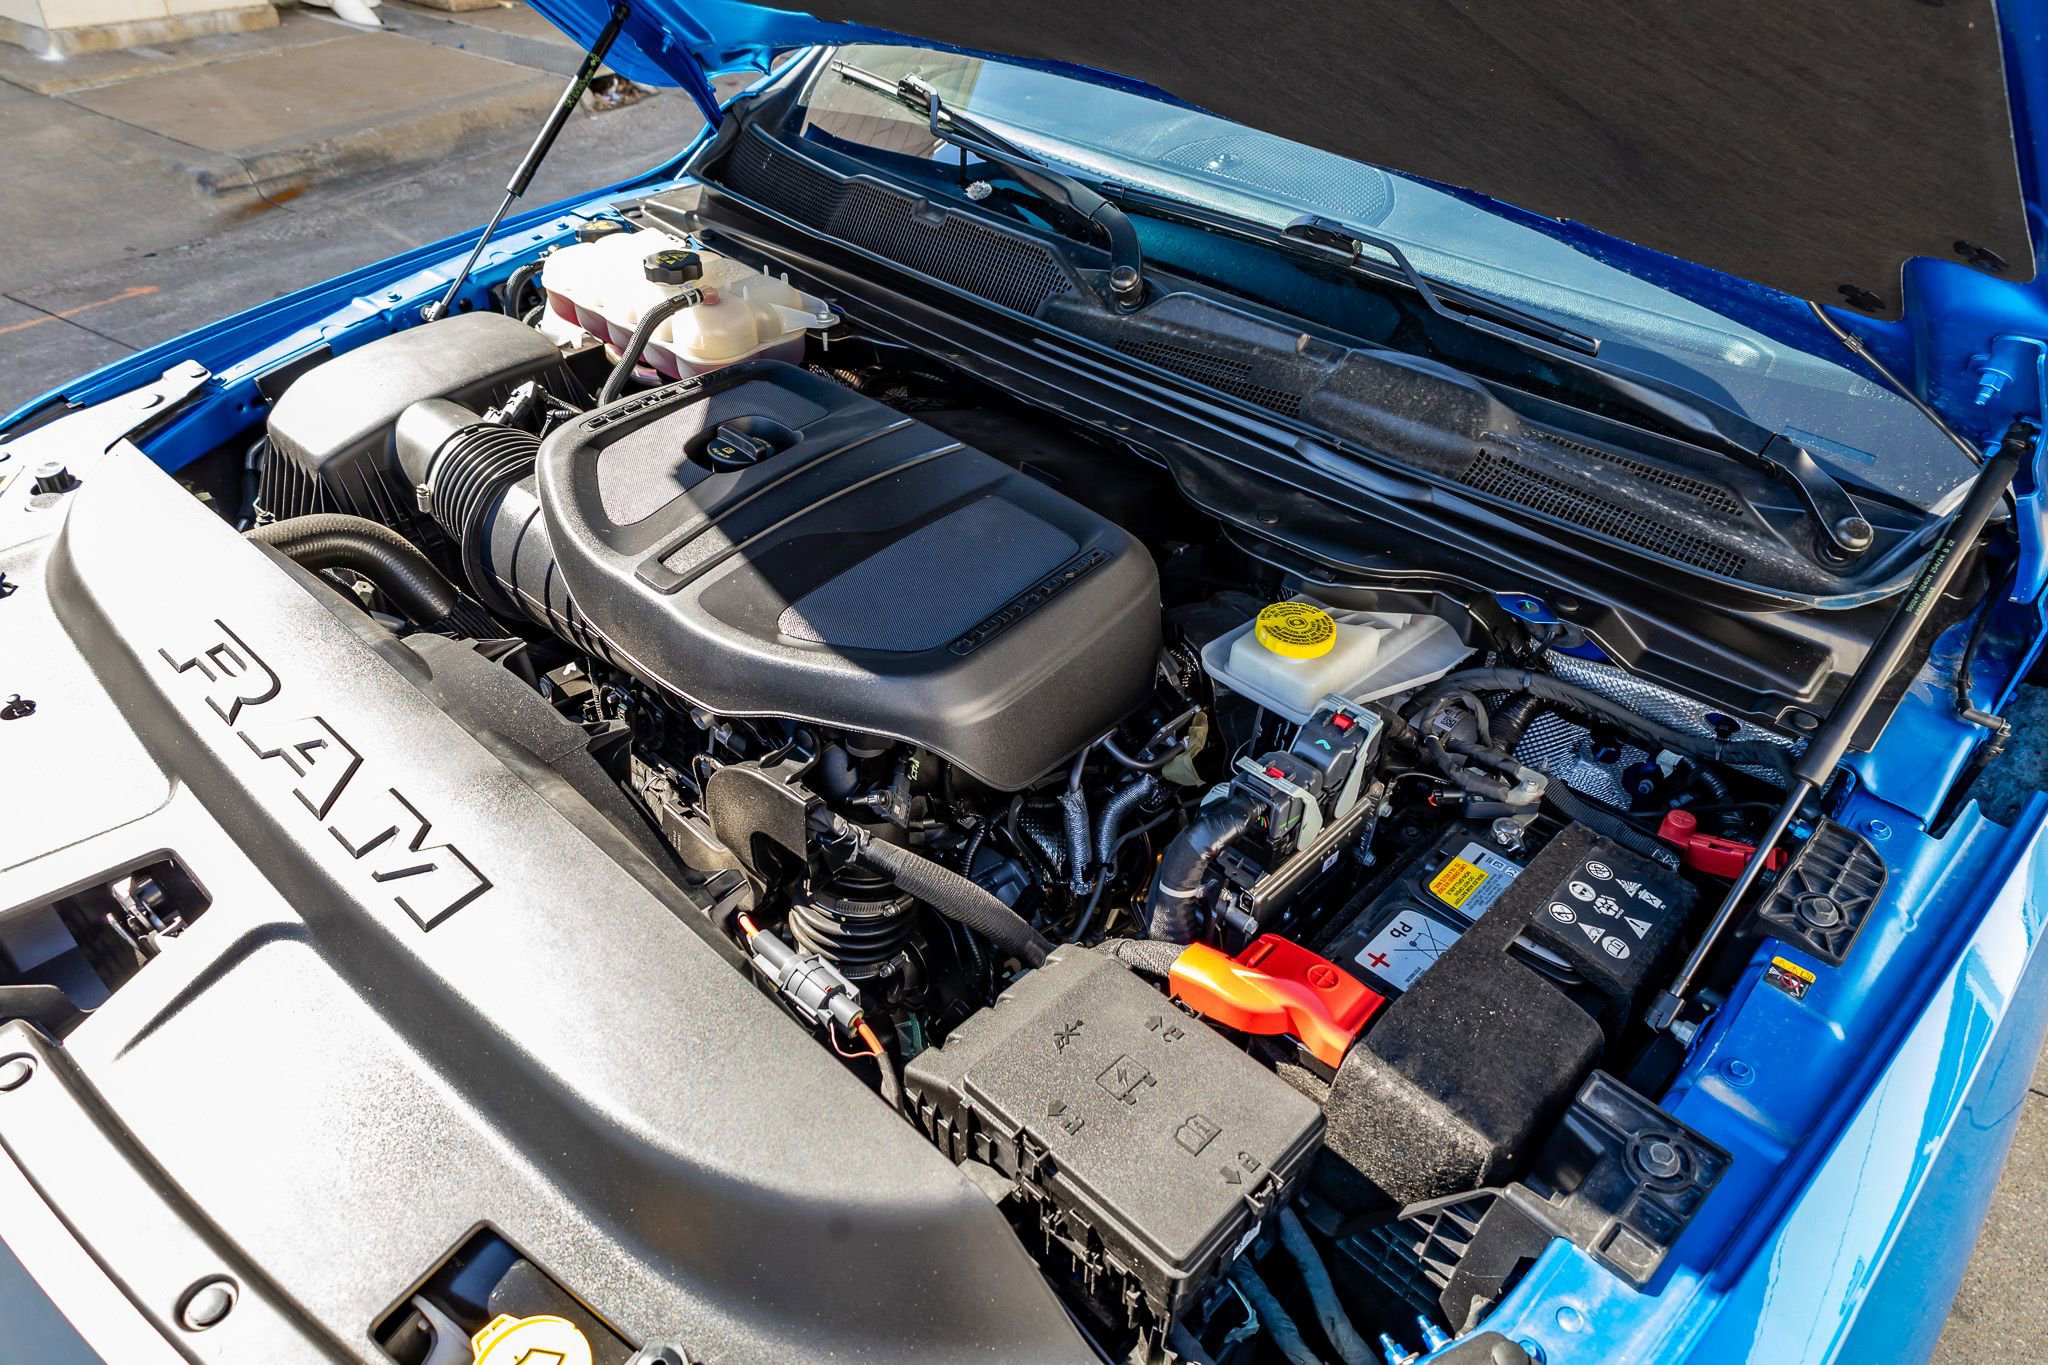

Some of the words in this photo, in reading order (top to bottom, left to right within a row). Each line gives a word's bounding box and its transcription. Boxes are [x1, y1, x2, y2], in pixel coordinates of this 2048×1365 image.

[1024, 550, 1105, 600] TURBO
[158, 618, 494, 933] RAM
[1453, 891, 1468, 904] BATTERY
[1389, 920, 1413, 938] Pb
